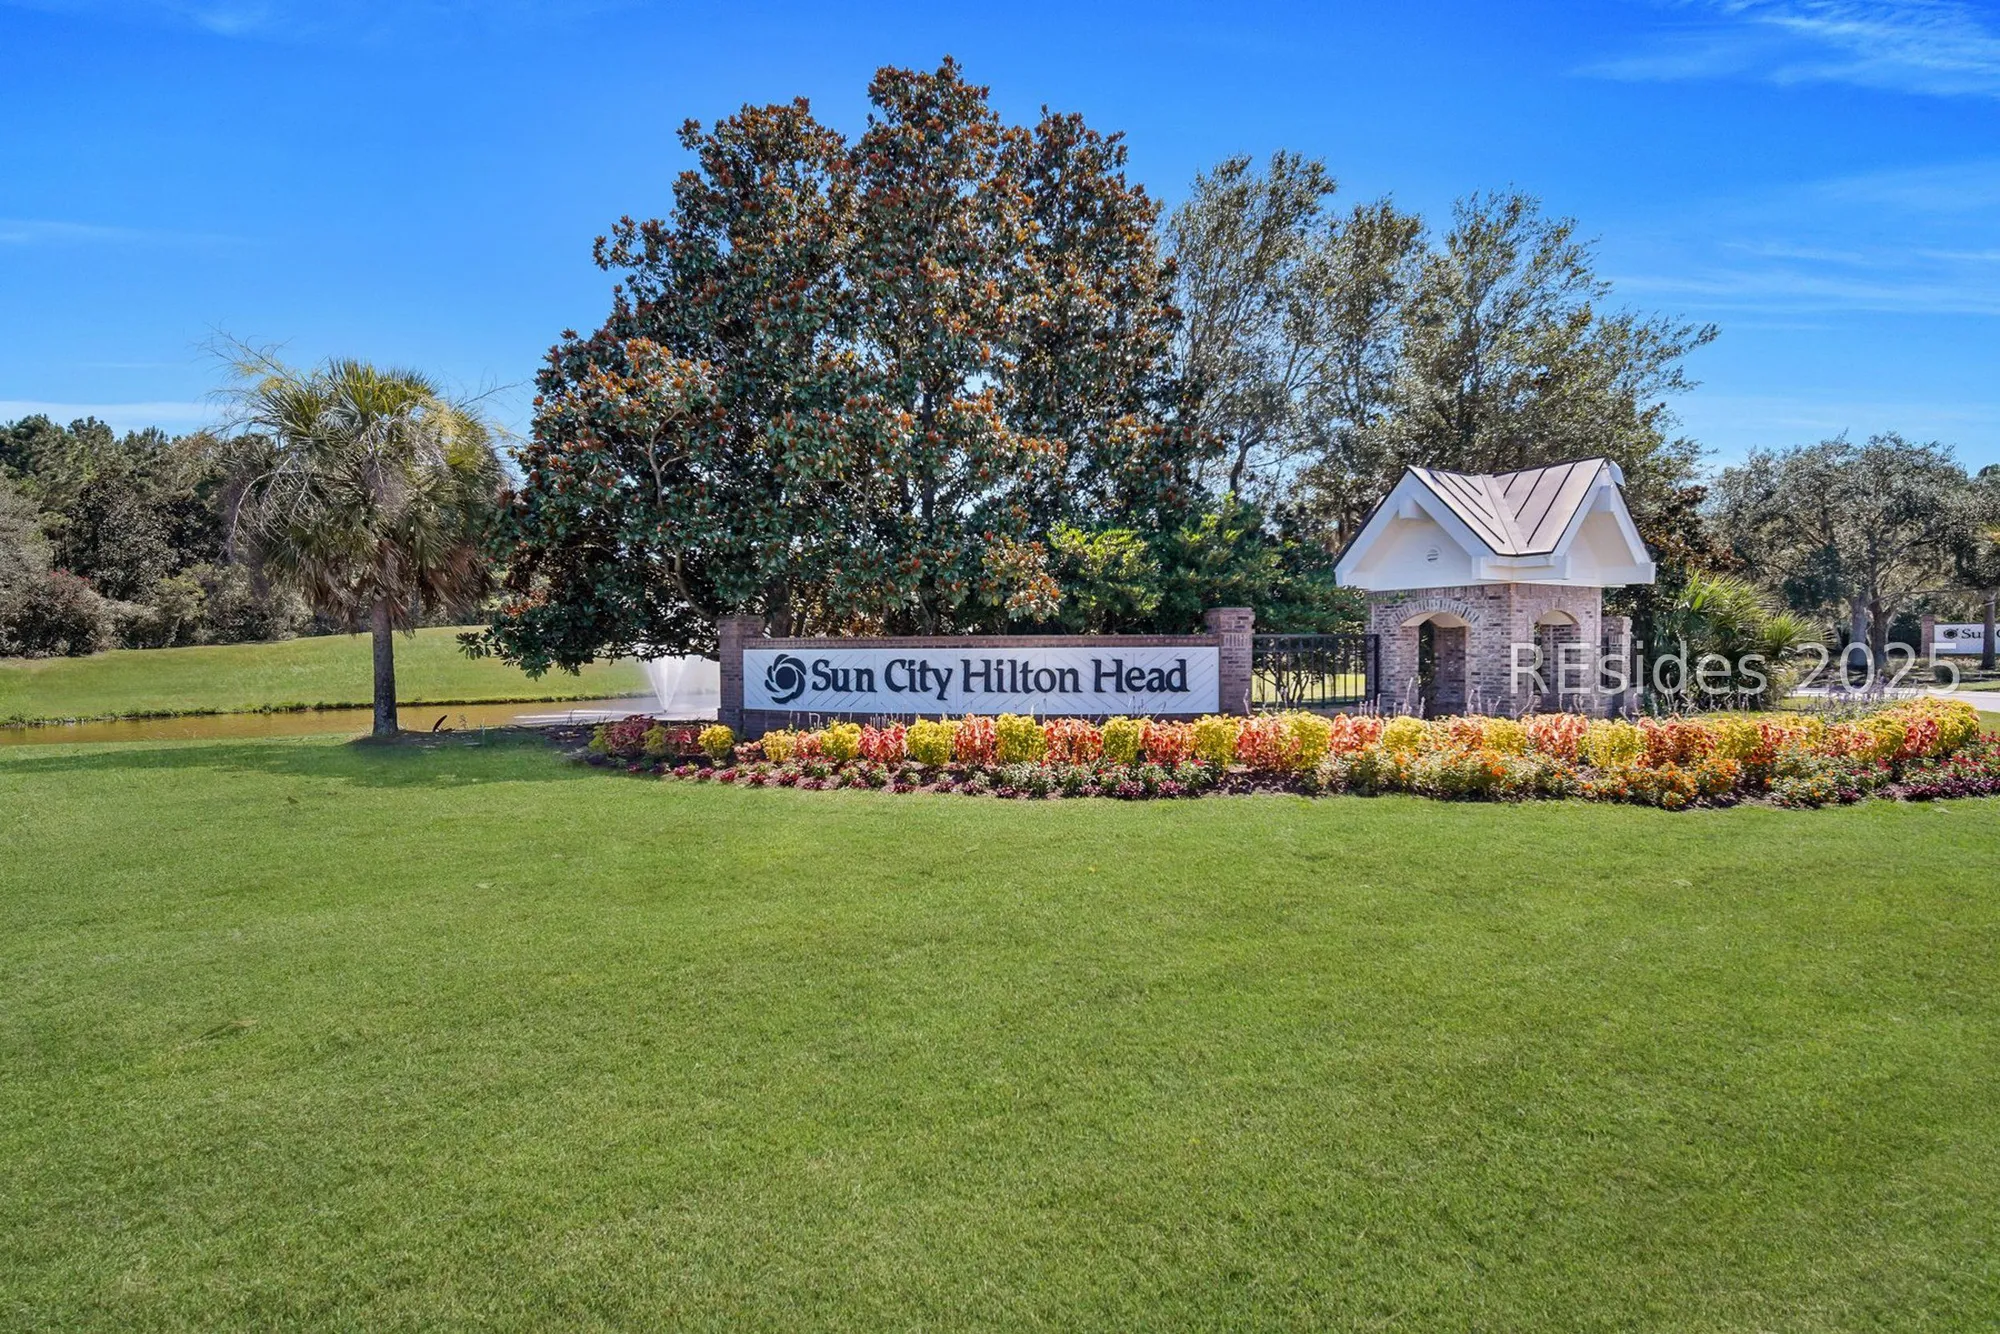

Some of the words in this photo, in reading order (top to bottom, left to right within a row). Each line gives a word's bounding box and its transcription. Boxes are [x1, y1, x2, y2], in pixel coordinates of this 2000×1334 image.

[1961, 628, 1985, 639] Su
[811, 660, 877, 693] Sun
[884, 659, 953, 700] City
[960, 659, 1083, 694] Hilton
[1091, 658, 1190, 693] Head
